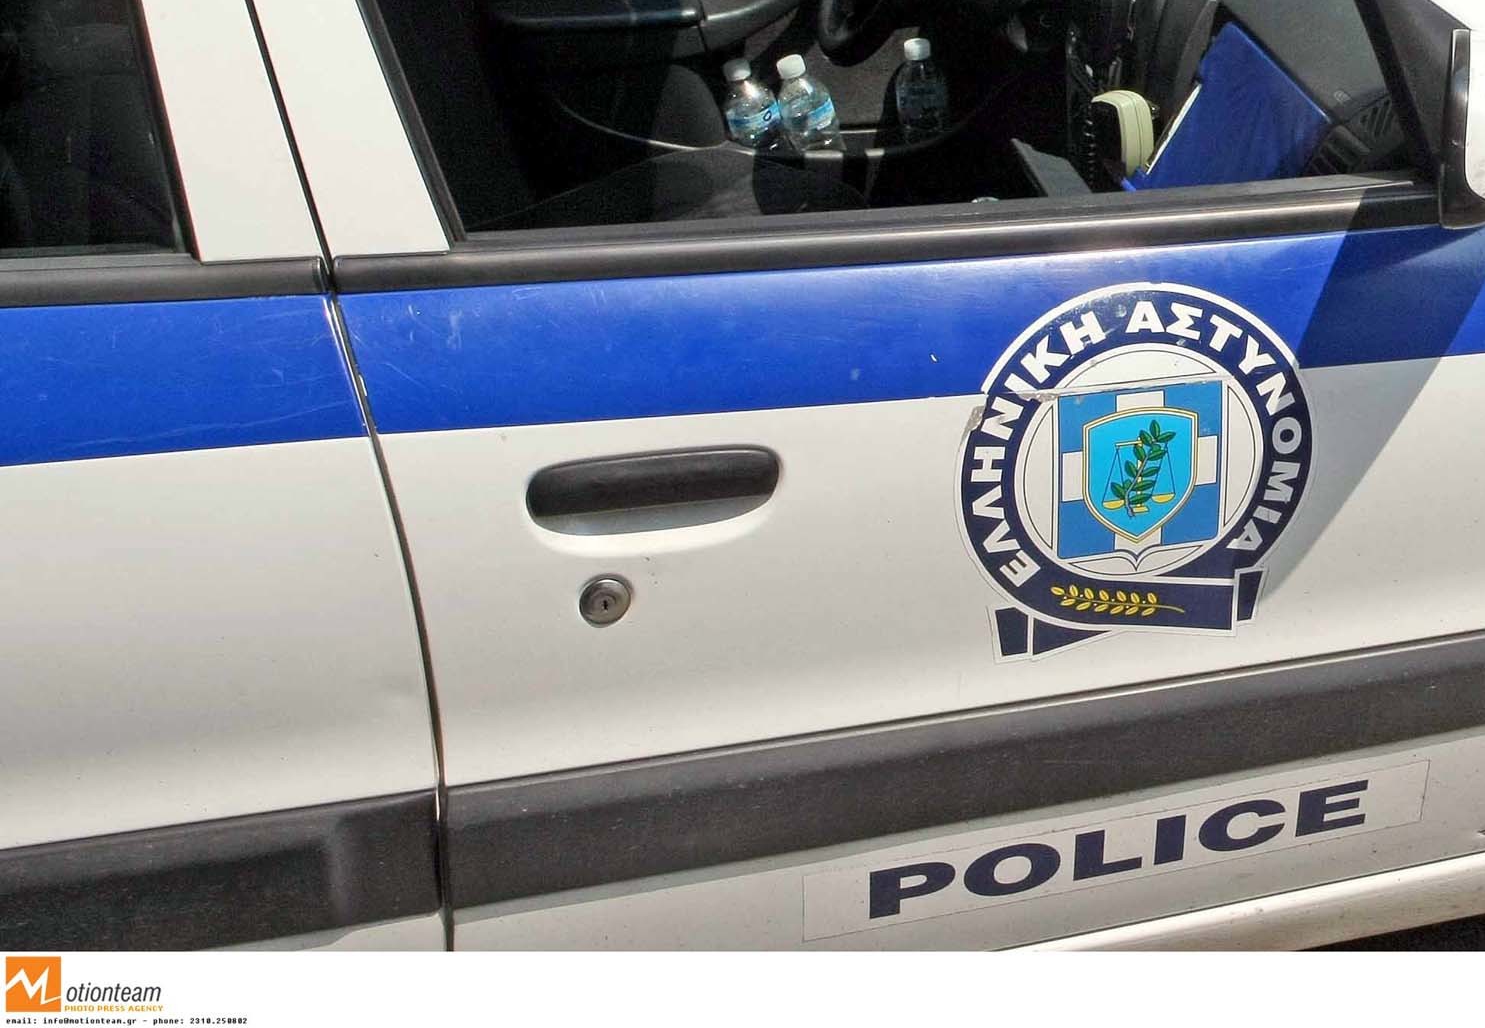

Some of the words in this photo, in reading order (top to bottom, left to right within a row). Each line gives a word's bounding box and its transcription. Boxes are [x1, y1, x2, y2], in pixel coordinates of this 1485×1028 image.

[971, 310, 1107, 588] ΕΛΛΗΝΙΚΗ
[1125, 300, 1303, 553] ΑΣΤΥΝΟΜΙΑ
[868, 779, 1370, 921] POLICE
